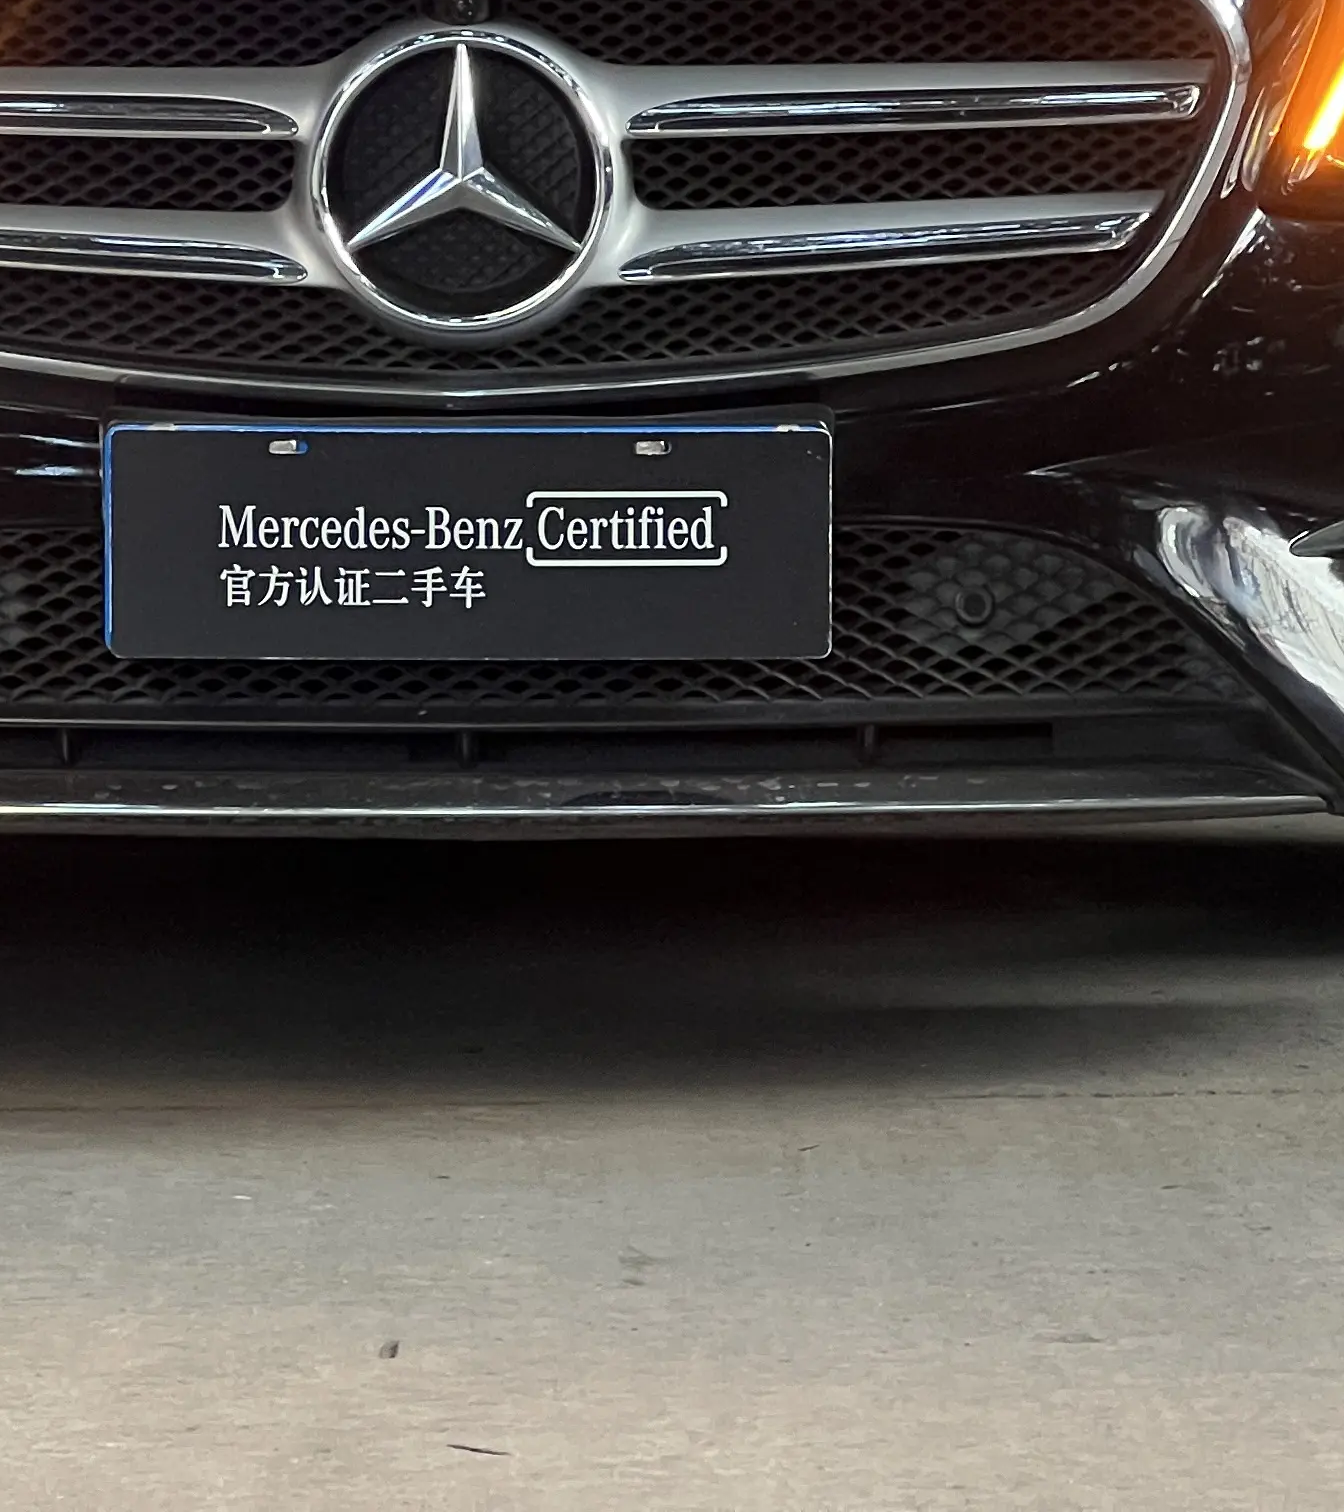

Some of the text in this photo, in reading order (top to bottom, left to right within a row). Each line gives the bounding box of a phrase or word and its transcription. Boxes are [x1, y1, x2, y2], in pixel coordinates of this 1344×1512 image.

[217, 504, 716, 550] Mercedes-Benz Certified
[219, 563, 486, 609] 官方认证二手车
